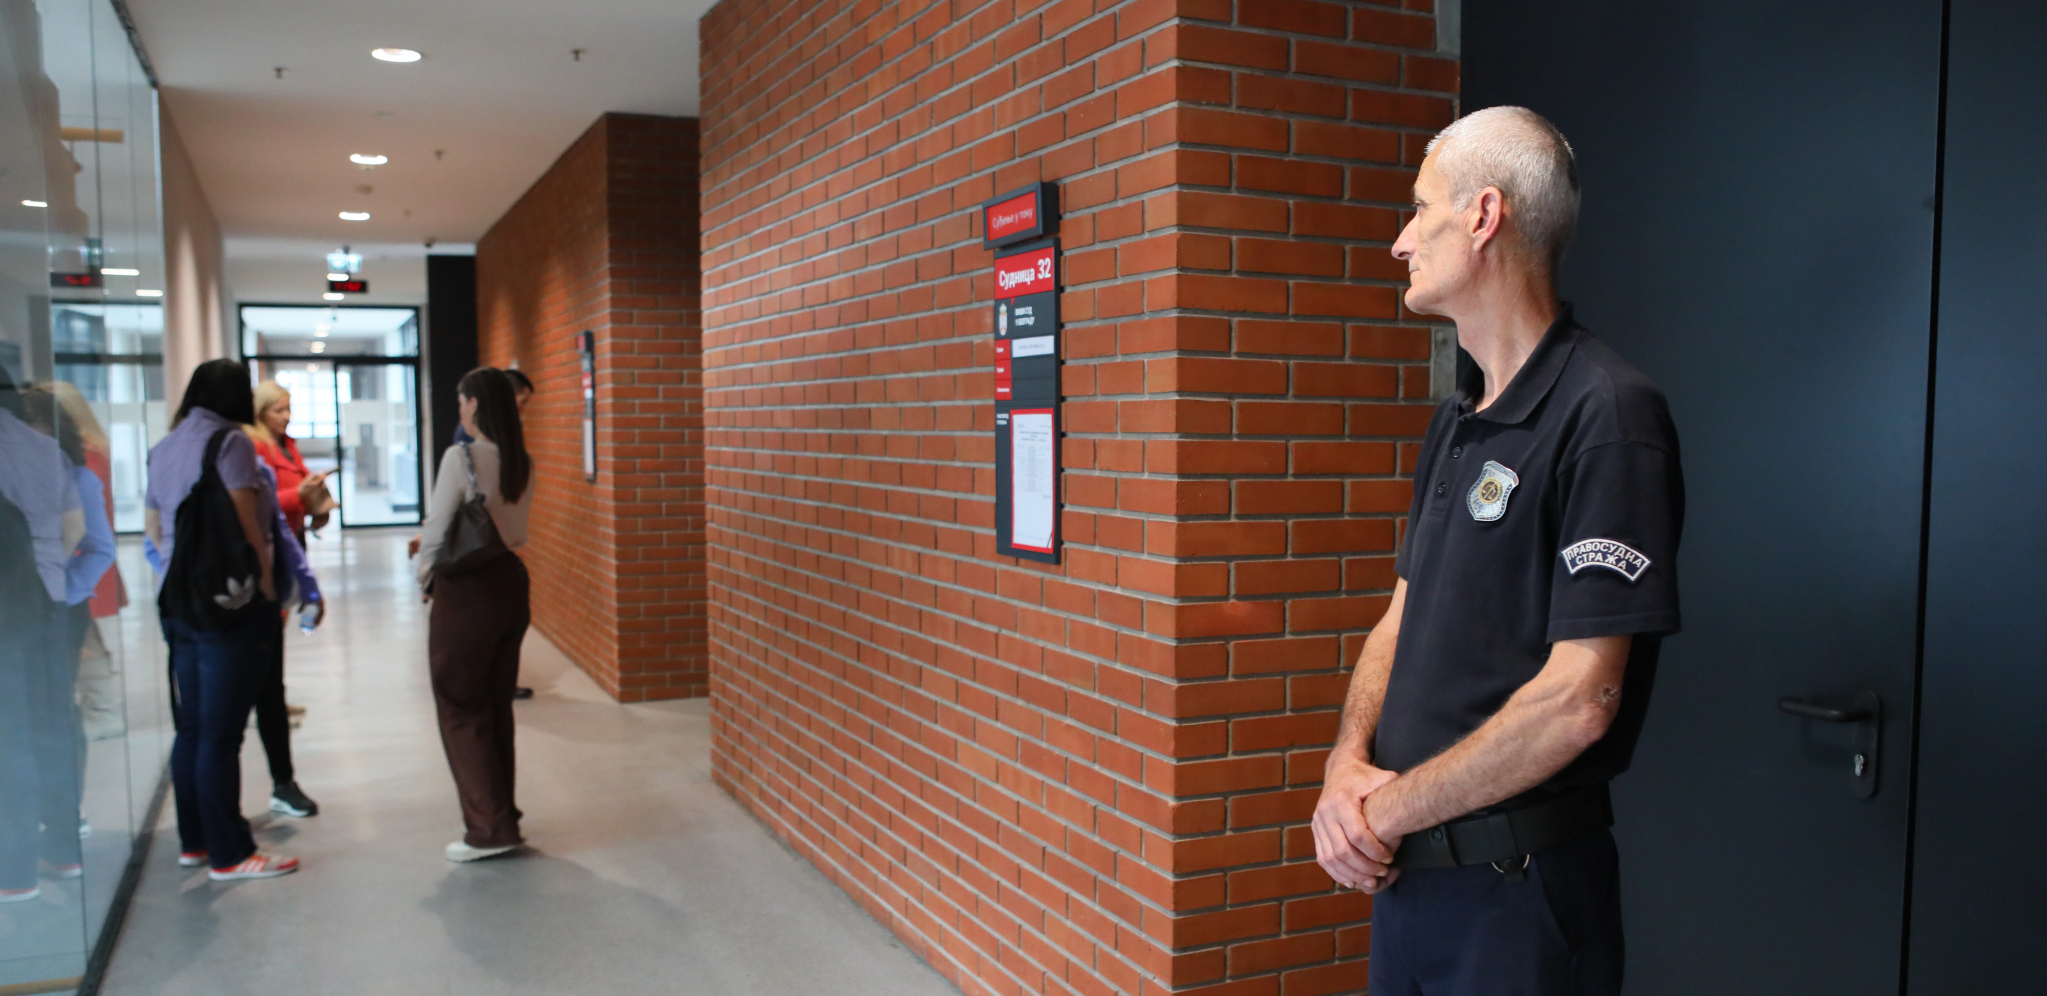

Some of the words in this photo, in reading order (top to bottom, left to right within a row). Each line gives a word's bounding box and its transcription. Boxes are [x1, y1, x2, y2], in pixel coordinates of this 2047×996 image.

[999, 268, 1035, 290] Судница
[1037, 257, 1052, 280] 32
[1566, 542, 1643, 568] ПРАВОСУДНА
[1575, 552, 1627, 570] СТРАЖА
